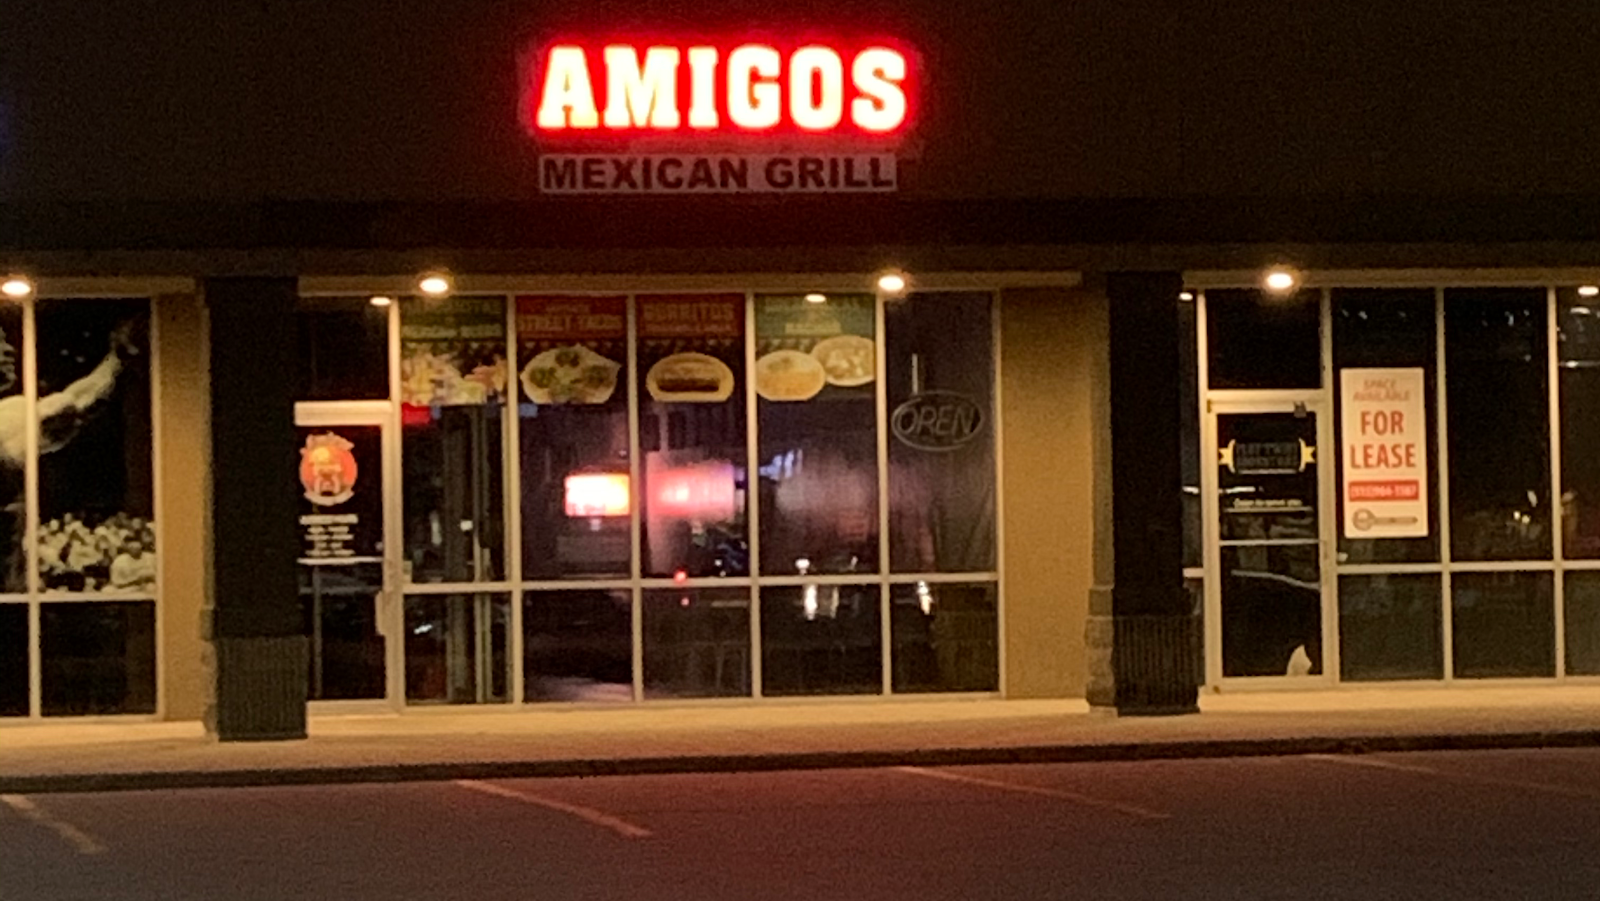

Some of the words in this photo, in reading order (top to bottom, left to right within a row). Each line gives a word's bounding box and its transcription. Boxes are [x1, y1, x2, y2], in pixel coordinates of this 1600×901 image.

[537, 44, 906, 130] AMIGOS
[544, 158, 748, 189] MEXICAN
[765, 158, 893, 189] GRILL
[1361, 411, 1404, 436] FOR
[1351, 444, 1416, 469] LEASE
